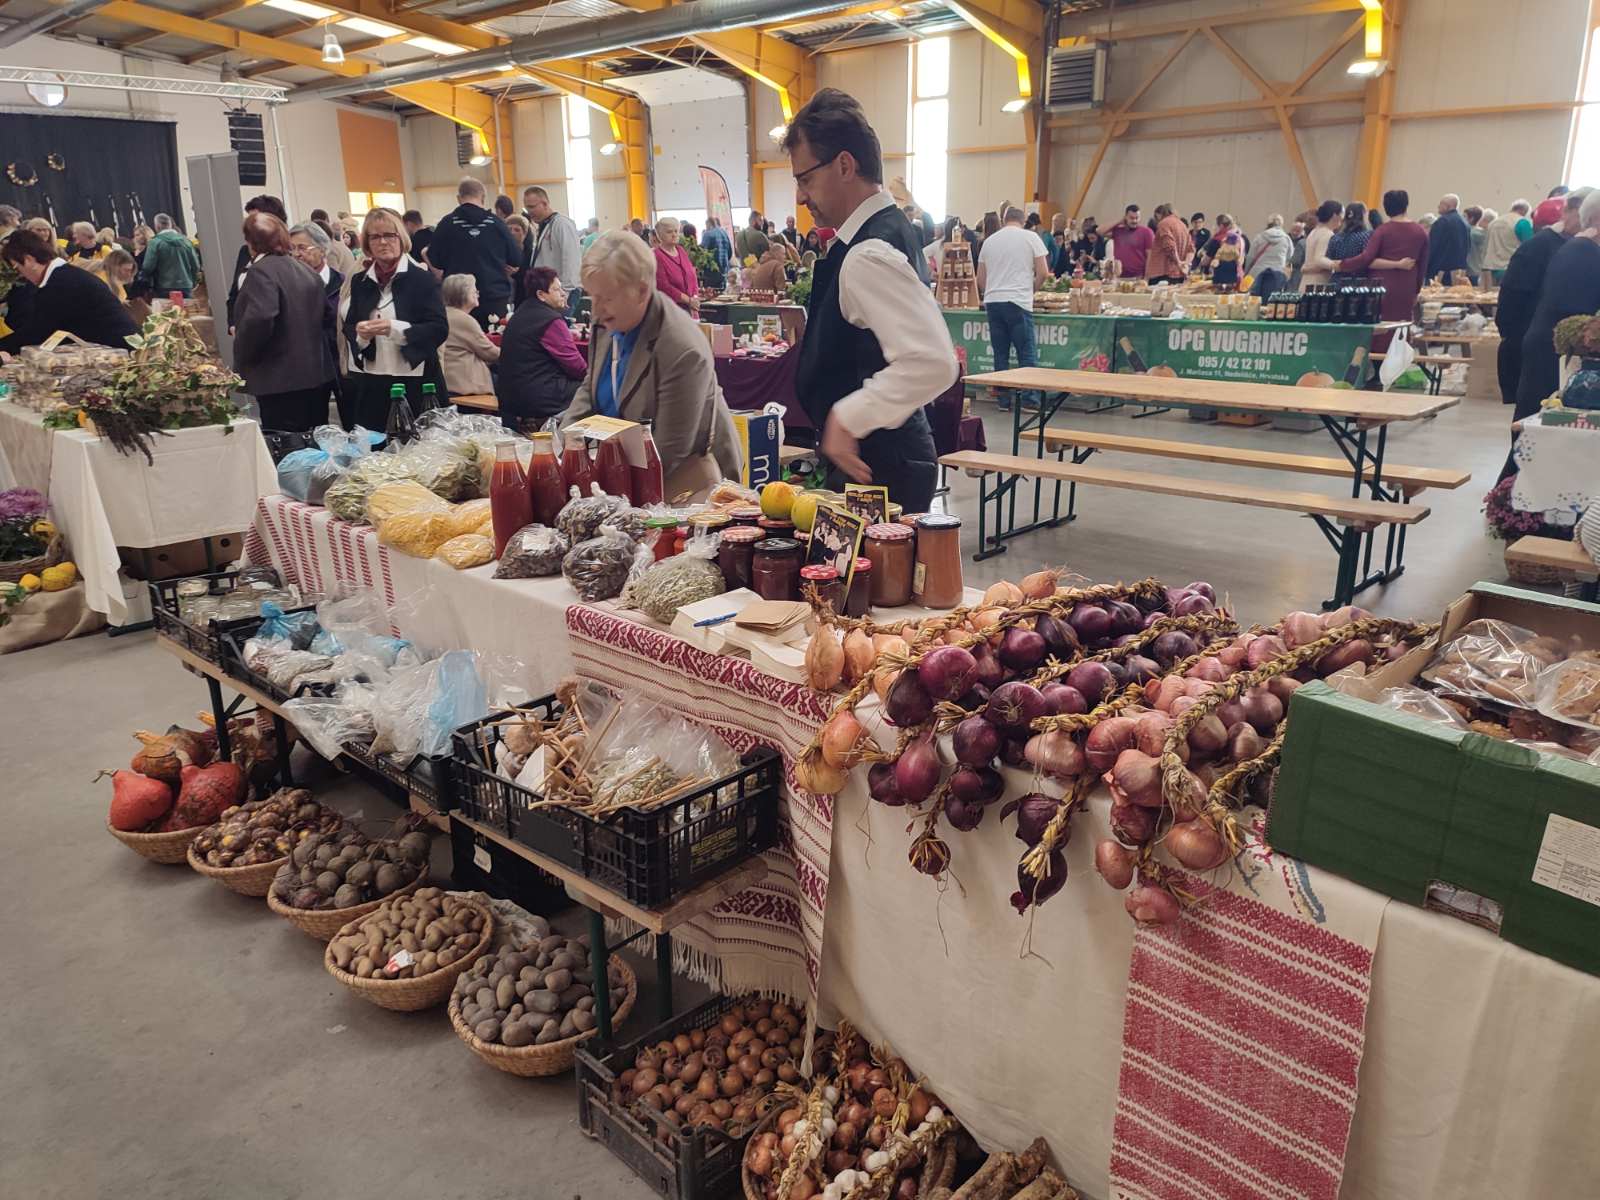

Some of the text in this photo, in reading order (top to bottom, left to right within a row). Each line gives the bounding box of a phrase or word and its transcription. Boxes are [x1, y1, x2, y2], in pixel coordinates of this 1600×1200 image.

[963, 321, 991, 342] OPG
[1168, 328, 1309, 356] OPG VUGRINEC
[1198, 355, 1218, 369] 095
[1226, 357, 1239, 369] 42
[1241, 358, 1252, 370] 12
[1254, 359, 1272, 371] 101
